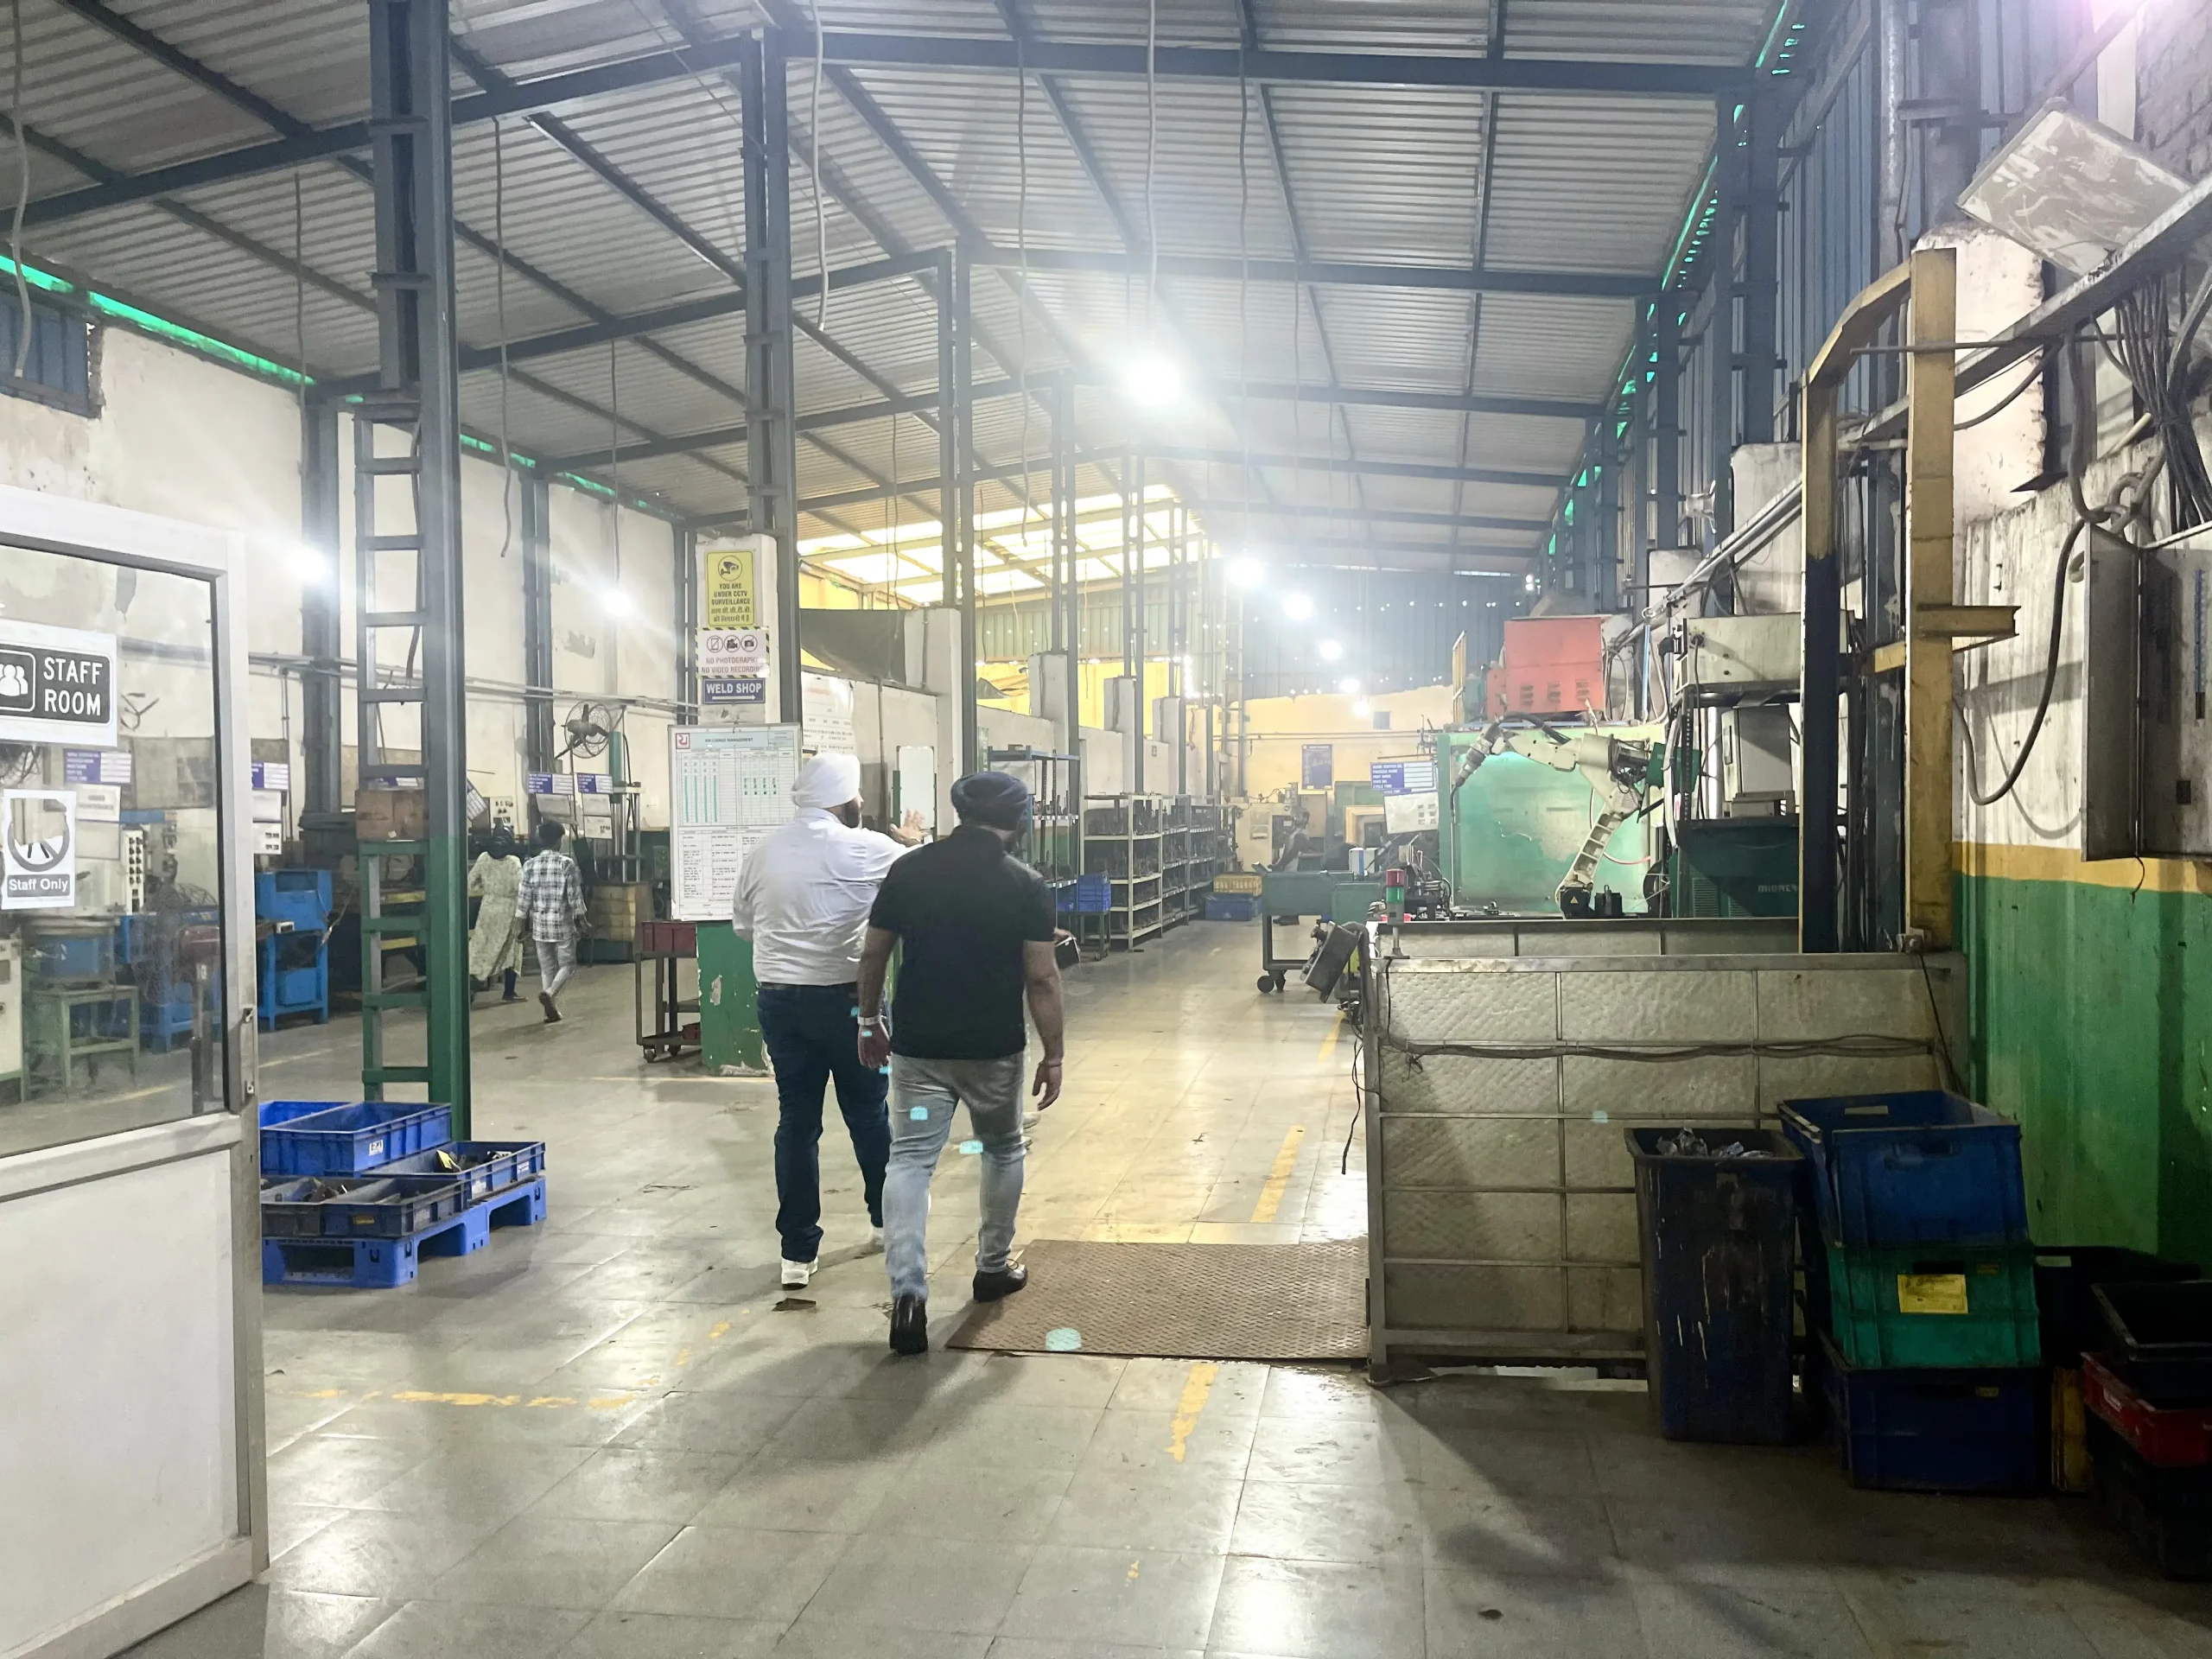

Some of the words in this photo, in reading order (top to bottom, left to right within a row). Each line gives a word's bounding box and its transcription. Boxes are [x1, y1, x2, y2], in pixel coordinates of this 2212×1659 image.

[43, 656, 103, 684] STAFF
[706, 683, 734, 694] WELD
[735, 683, 762, 694] SHOP
[44, 688, 101, 716] ROOM
[9, 878, 37, 891] Staff
[40, 877, 69, 893] Only
